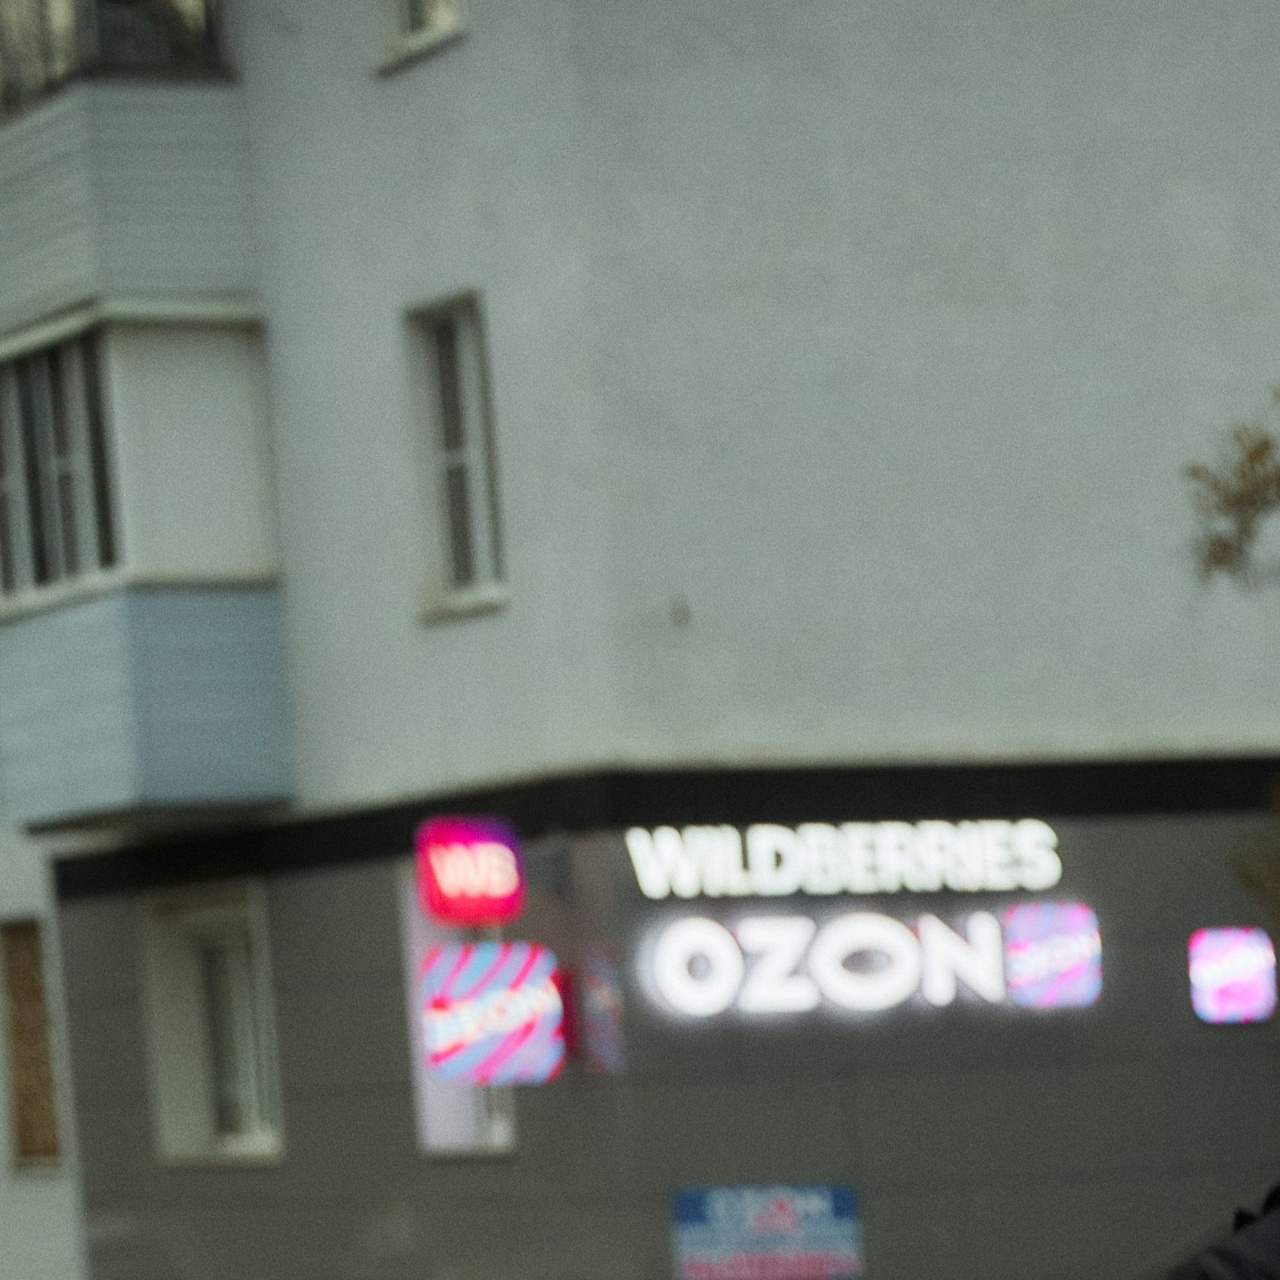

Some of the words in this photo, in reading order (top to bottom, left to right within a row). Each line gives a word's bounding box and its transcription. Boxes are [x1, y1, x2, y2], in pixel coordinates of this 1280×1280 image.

[429, 842, 519, 898] WB
[626, 818, 1062, 898] WILDBERRIES
[654, 911, 1005, 1017] OZON
